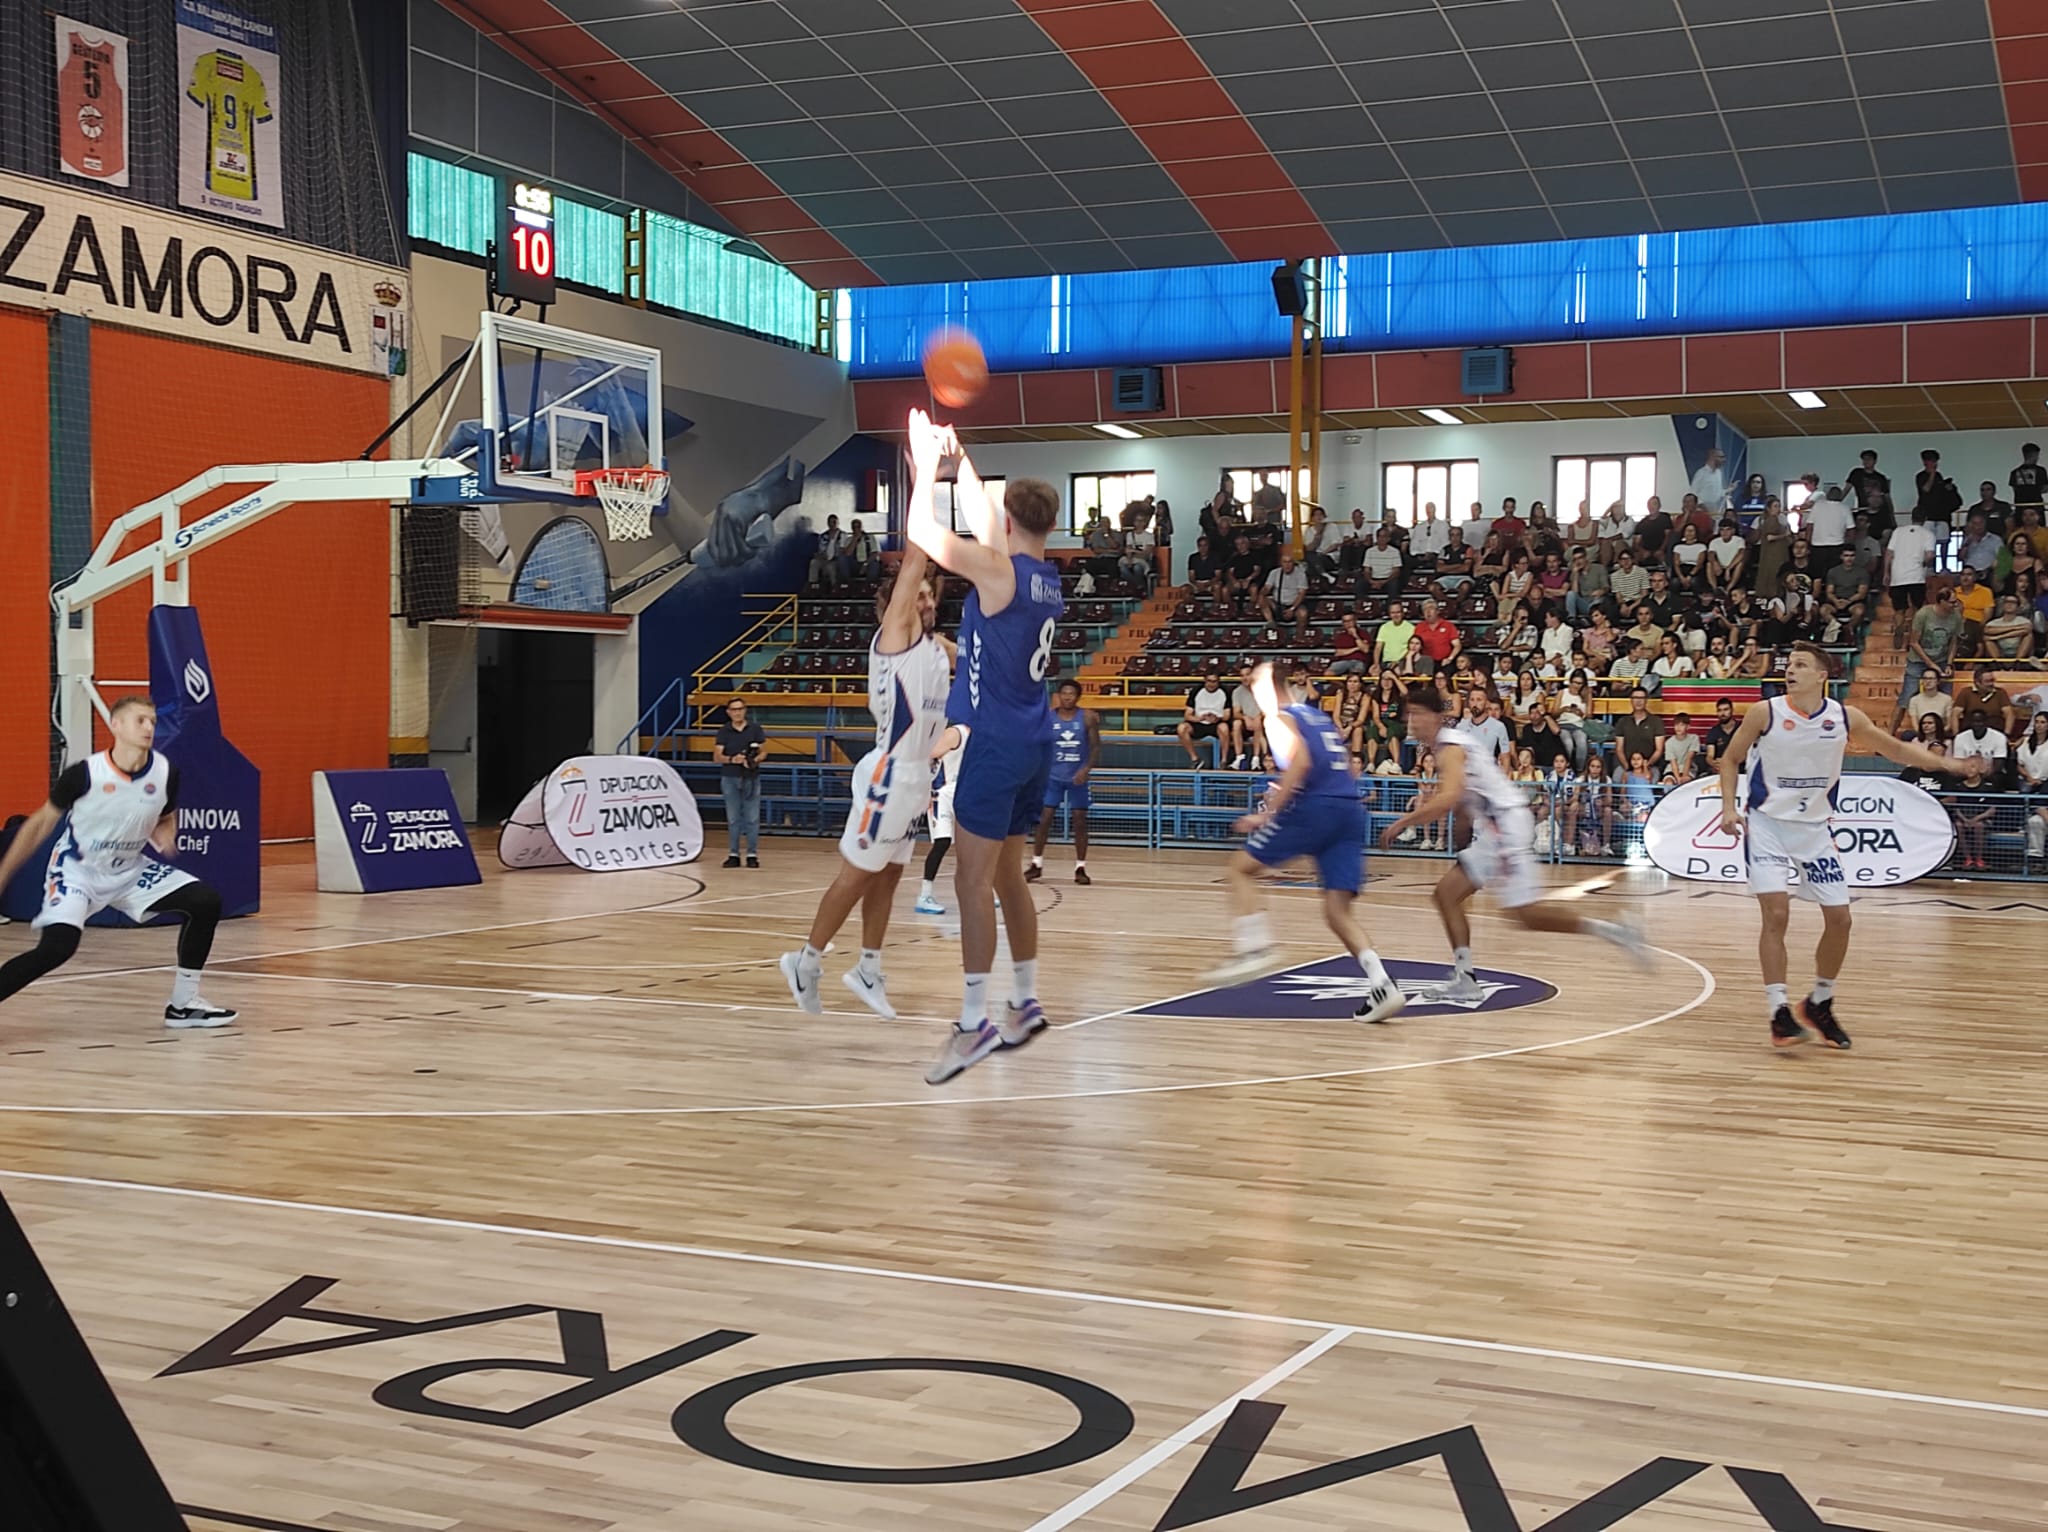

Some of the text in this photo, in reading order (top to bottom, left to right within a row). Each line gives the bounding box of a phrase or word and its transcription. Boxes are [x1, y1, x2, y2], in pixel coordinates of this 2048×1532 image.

[83, 61, 101, 99] 5
[223, 94, 237, 130] 9
[512, 226, 551, 276] 10
[0, 195, 352, 354] ZAMORA
[1029, 617, 1055, 682] 8
[178, 807, 241, 831] INNOVA
[599, 803, 680, 834] ZAMORA
[177, 835, 211, 855] Chef
[388, 829, 464, 851] ZAMORA
[575, 841, 688, 868] Deportes
